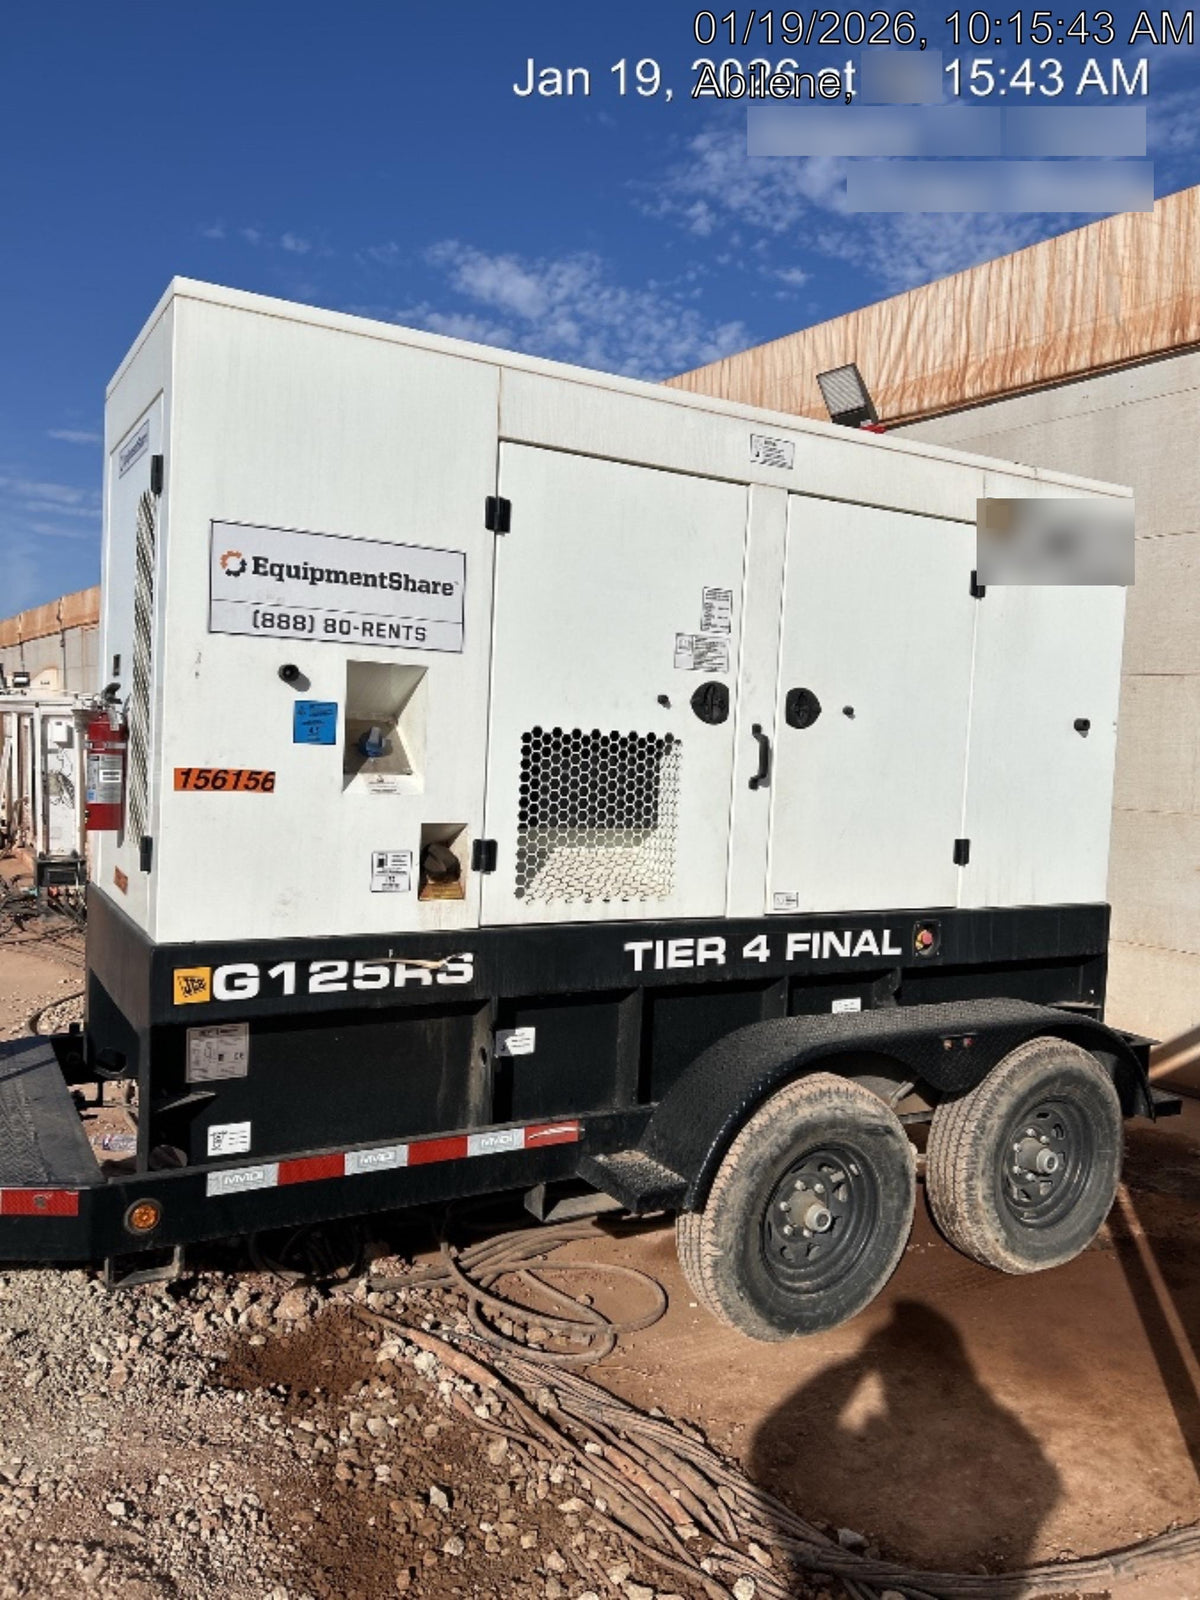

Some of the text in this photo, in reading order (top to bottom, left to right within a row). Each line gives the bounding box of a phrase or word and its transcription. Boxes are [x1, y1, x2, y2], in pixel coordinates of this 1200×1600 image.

[251, 556, 454, 597] EquipmentShare
[252, 609, 427, 642] (888) 80-RENTS
[180, 767, 276, 792] 156156
[624, 929, 903, 972] TIER 4 FINAL
